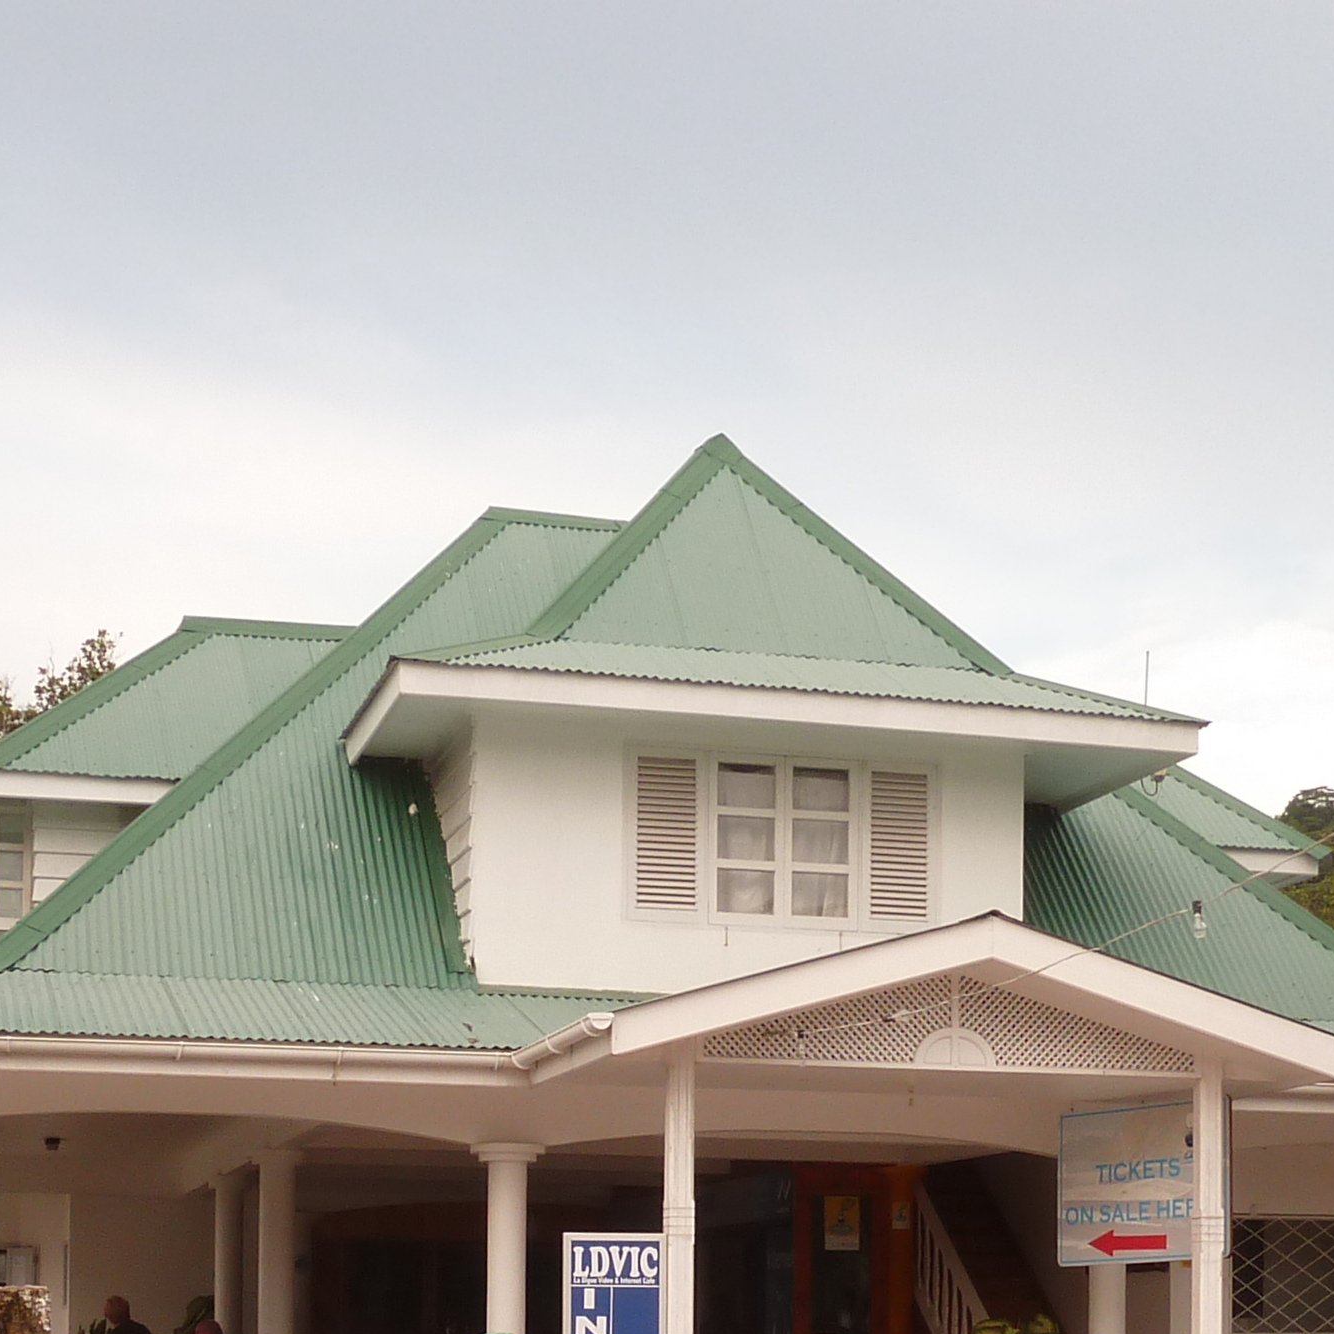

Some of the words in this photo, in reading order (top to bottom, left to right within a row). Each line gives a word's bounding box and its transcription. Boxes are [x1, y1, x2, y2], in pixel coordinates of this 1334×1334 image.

[1095, 1157, 1181, 1183] TICKETS
[1065, 1205, 1094, 1225] ON
[1099, 1201, 1152, 1223] SALE
[1156, 1198, 1194, 1219] HE
[572, 1245, 659, 1278] LDVIC
